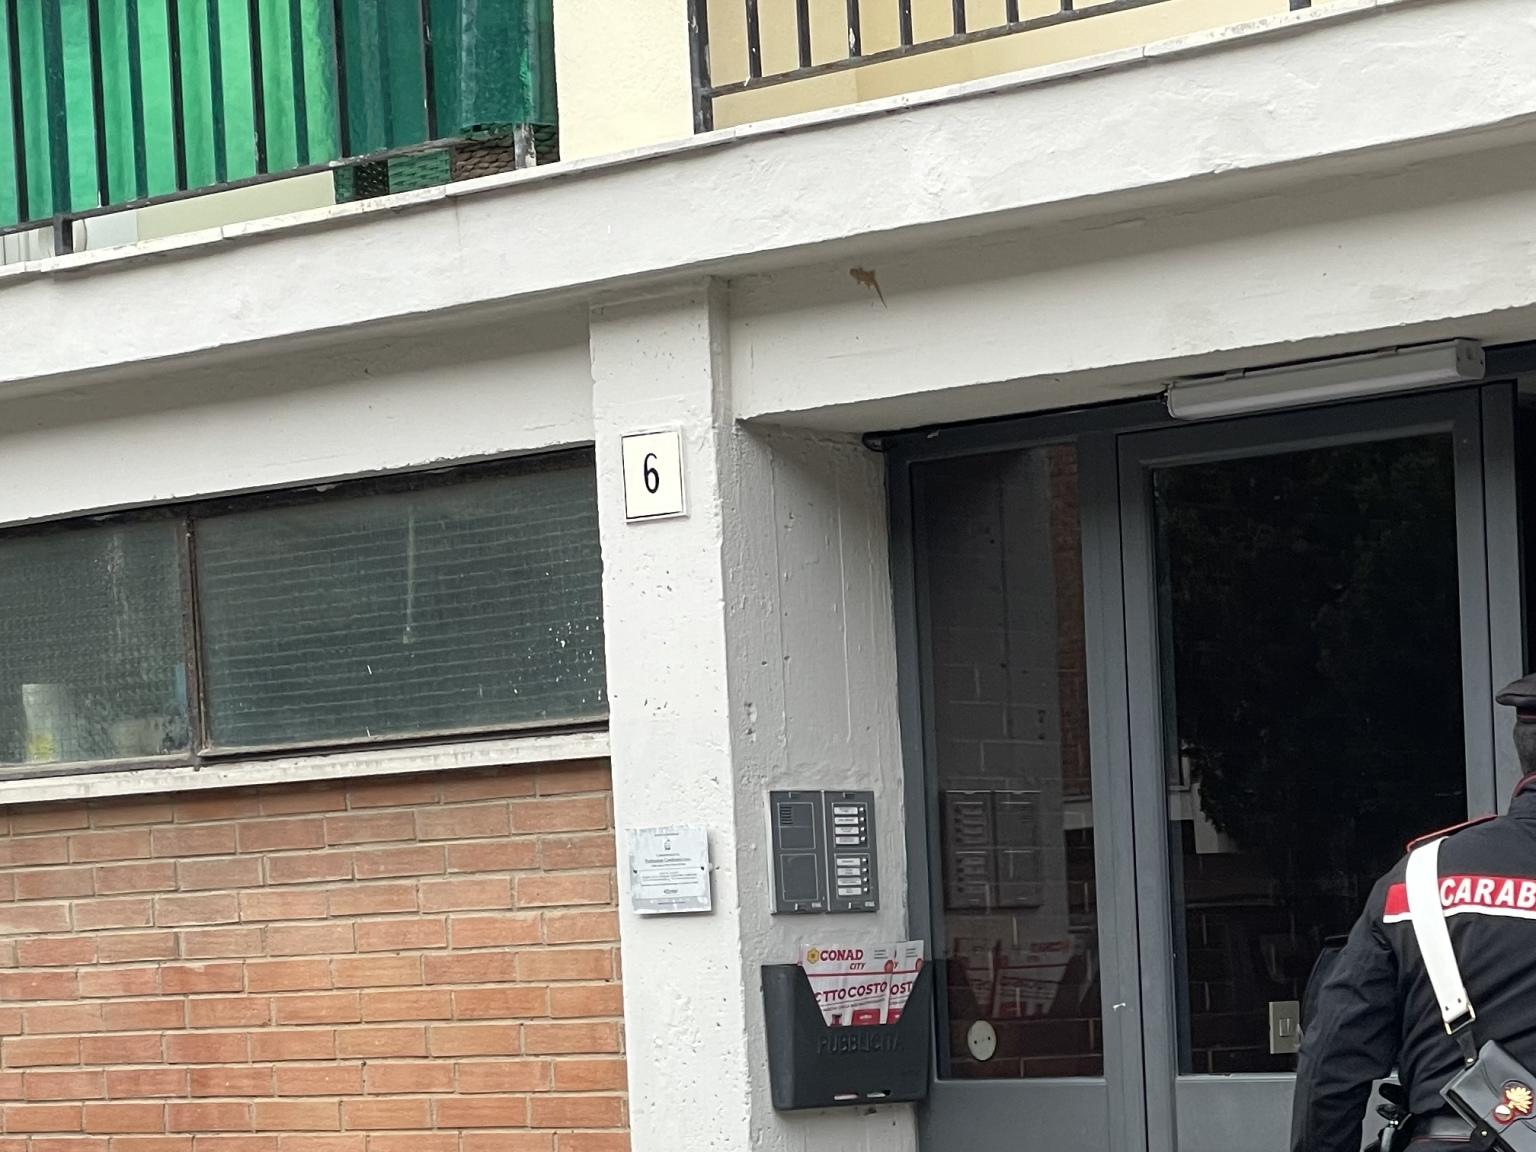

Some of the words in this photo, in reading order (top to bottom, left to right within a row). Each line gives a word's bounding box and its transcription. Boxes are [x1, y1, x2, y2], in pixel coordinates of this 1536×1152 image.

[644, 452, 660, 494] 6
[820, 949, 864, 961] CONAD
[849, 962, 866, 970] CITY
